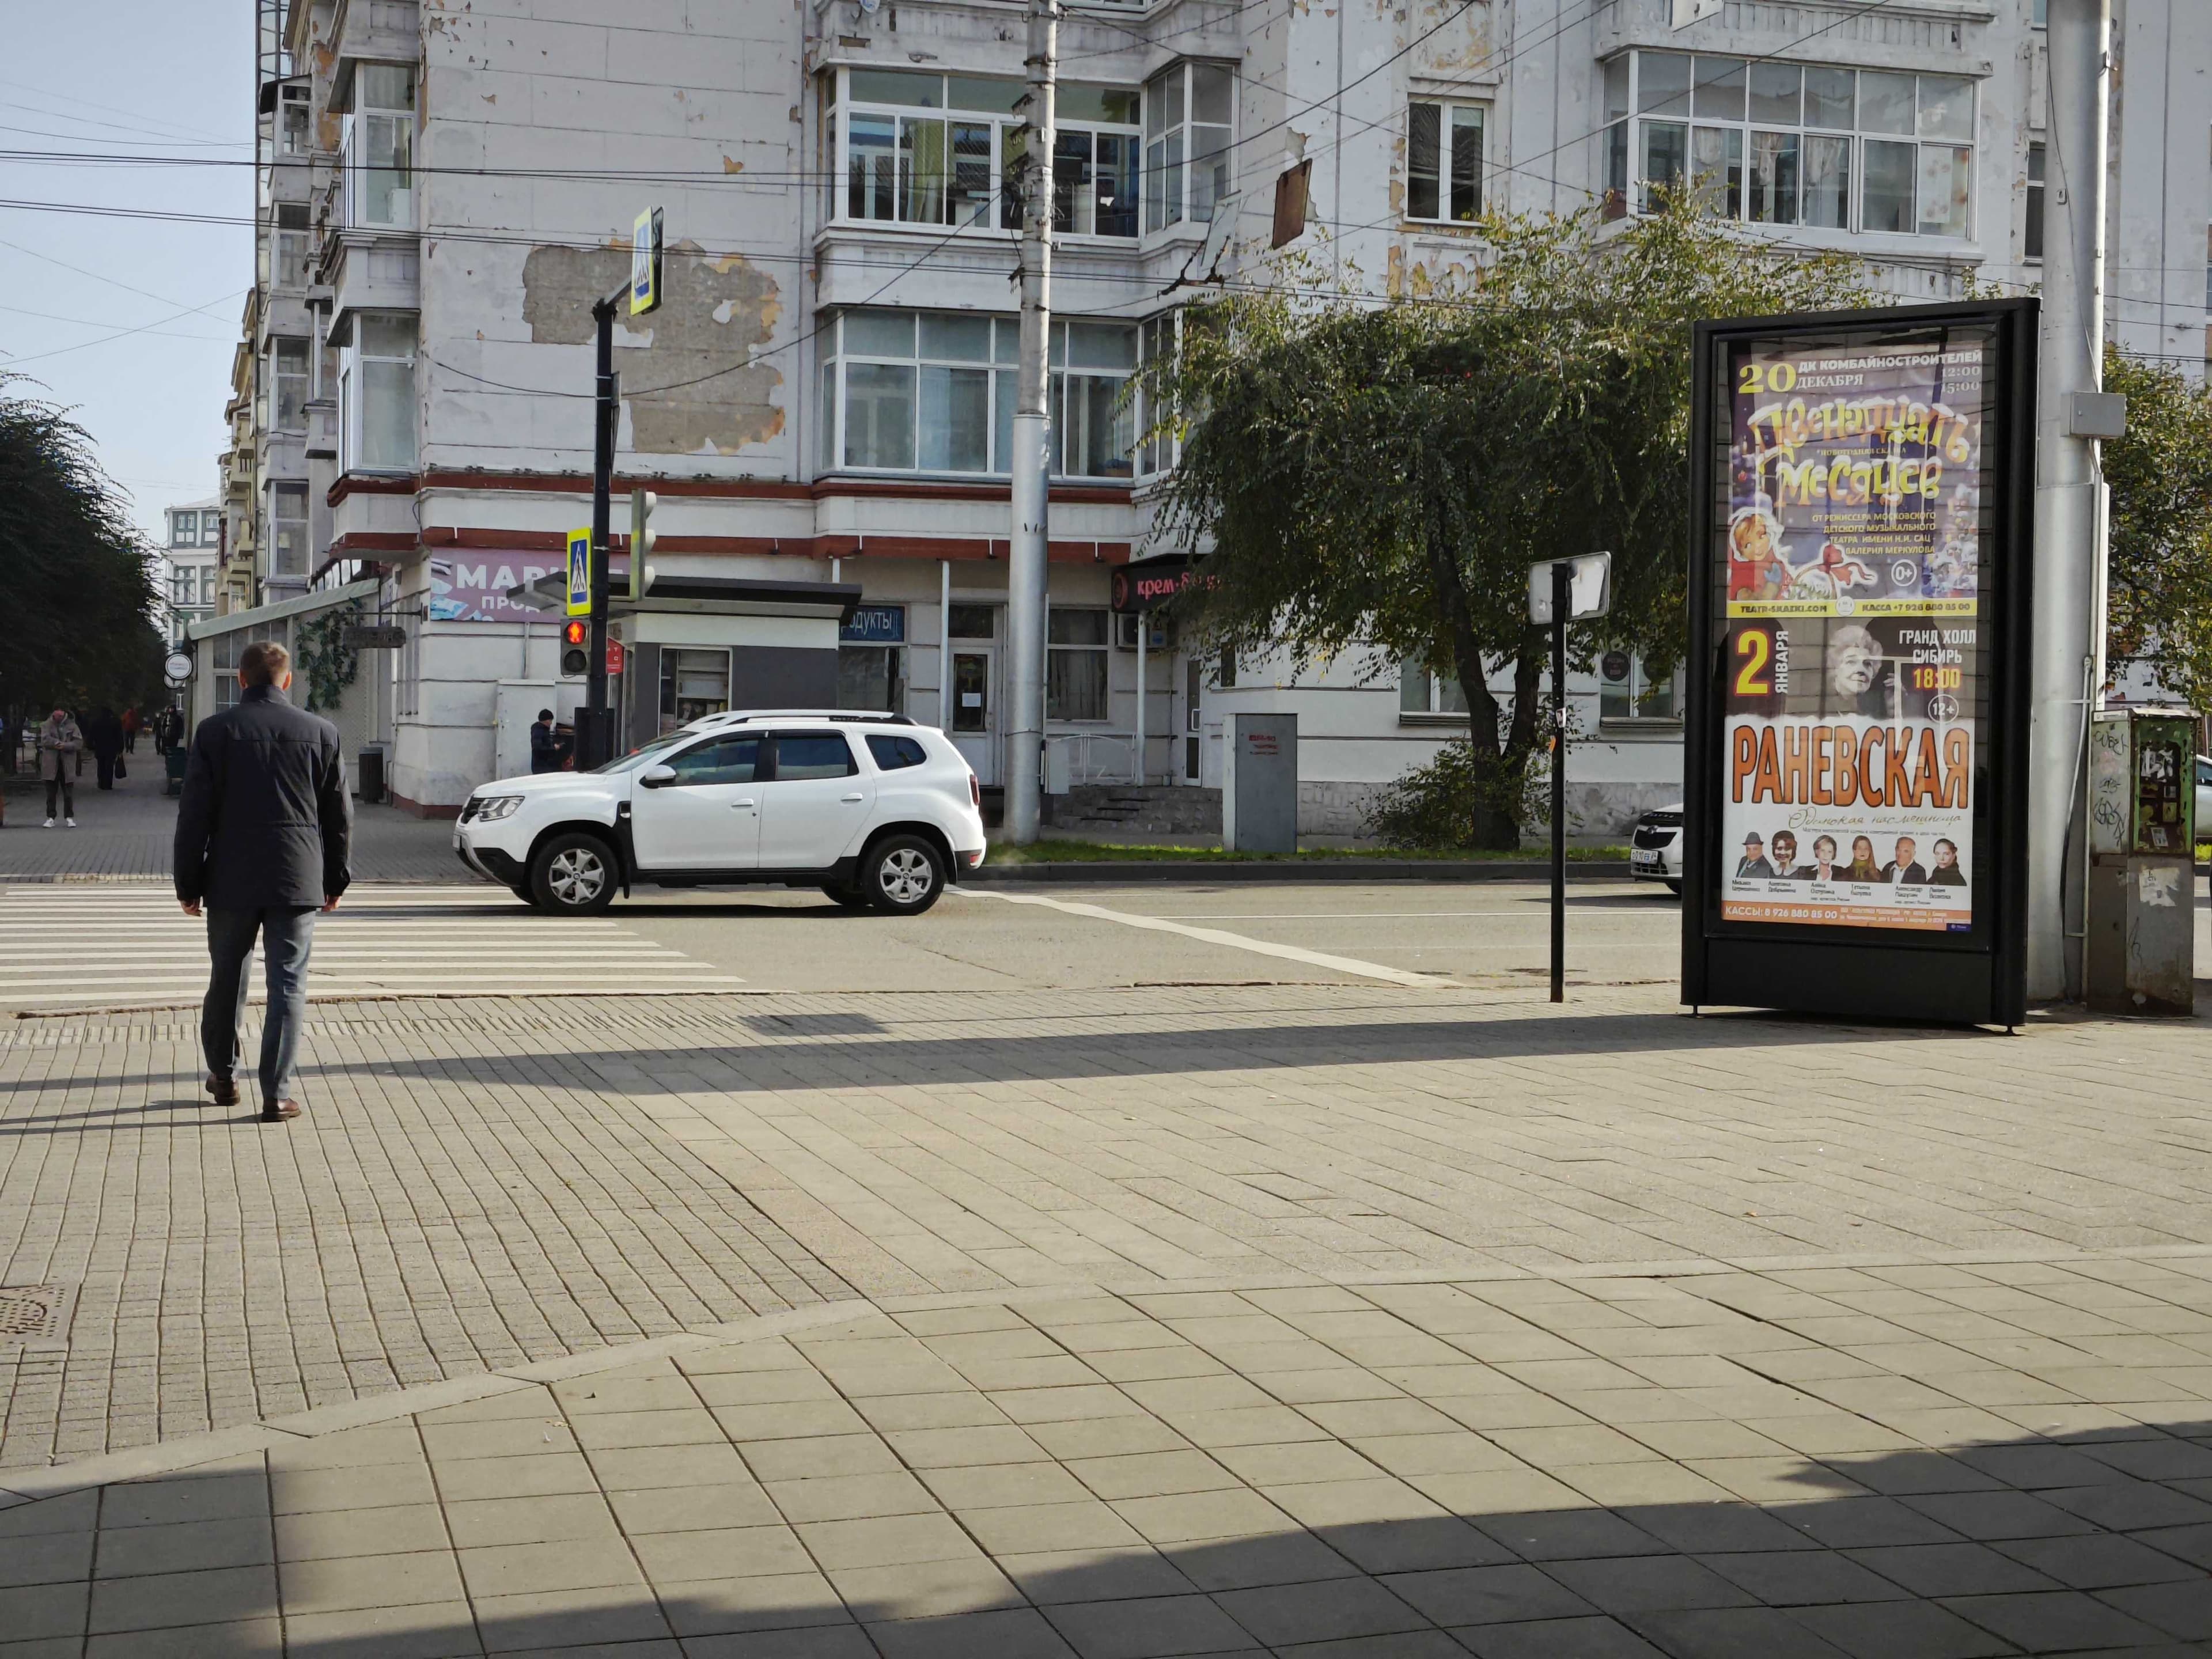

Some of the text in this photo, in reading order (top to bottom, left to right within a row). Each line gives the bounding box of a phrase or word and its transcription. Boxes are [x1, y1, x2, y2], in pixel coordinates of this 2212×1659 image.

[1798, 350, 1982, 374] ДК КОМБАЙНОСТРОИТЕЛЕЙ
[1737, 363, 1797, 394] 20
[1942, 366, 1981, 378] 12:00
[1796, 374, 1864, 390] ДЕКАБРЯ
[1941, 382, 1980, 394] 15:00
[1874, 512, 1936, 521] МОСКОВСКОГО
[1823, 524, 1936, 533] ДЕТСКОГО МУЗЫКАЛЬНОГО
[1885, 546, 1936, 554] МЕРКУЛОВА
[1895, 566, 1913, 580] 0+
[1862, 604, 1892, 612] КАССА
[1899, 629, 1976, 645] ГРАНД ХОЛЛ
[1736, 630, 1769, 695] 2
[1775, 630, 1789, 694] ЯНВАРЯ
[1912, 649, 1962, 664] СИБИРЬ
[1913, 668, 1961, 689] 18:00
[1932, 703, 1955, 716] 12+
[1732, 725, 1970, 809] РАНЕВСКАЯ
[1772, 908, 1789, 917] 926
[1791, 910, 1809, 918] 880
[1810, 910, 1822, 918] 85
[1824, 911, 1838, 919] 00
